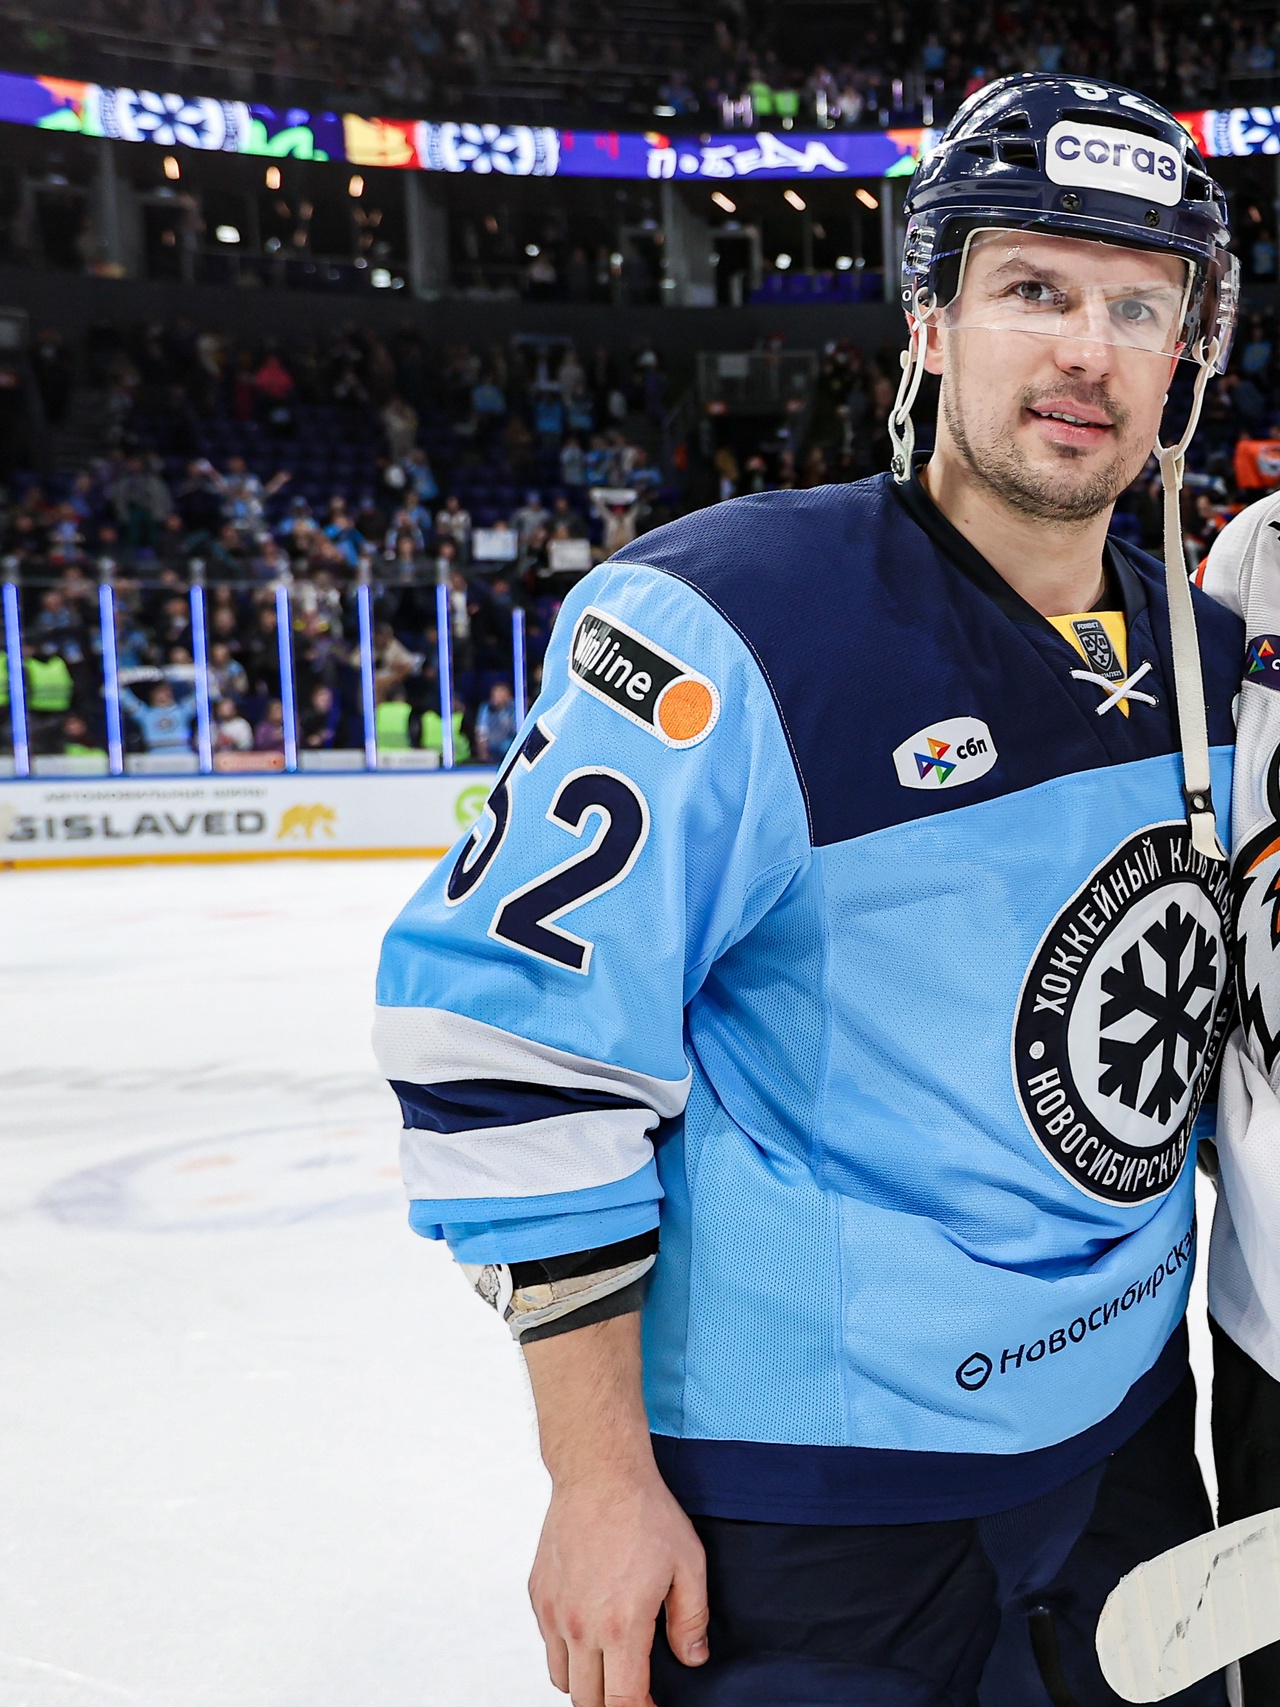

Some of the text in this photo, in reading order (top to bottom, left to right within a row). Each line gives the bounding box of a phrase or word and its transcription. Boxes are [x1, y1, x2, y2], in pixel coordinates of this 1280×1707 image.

[1055, 135, 1177, 182] согаз
[955, 736, 989, 762] сбп
[444, 715, 651, 975] 52
[1032, 837, 1162, 1016] ХОККЕЙНЫЙ
[1027, 1066, 1185, 1194] НОВОСИБИРСКАЯ
